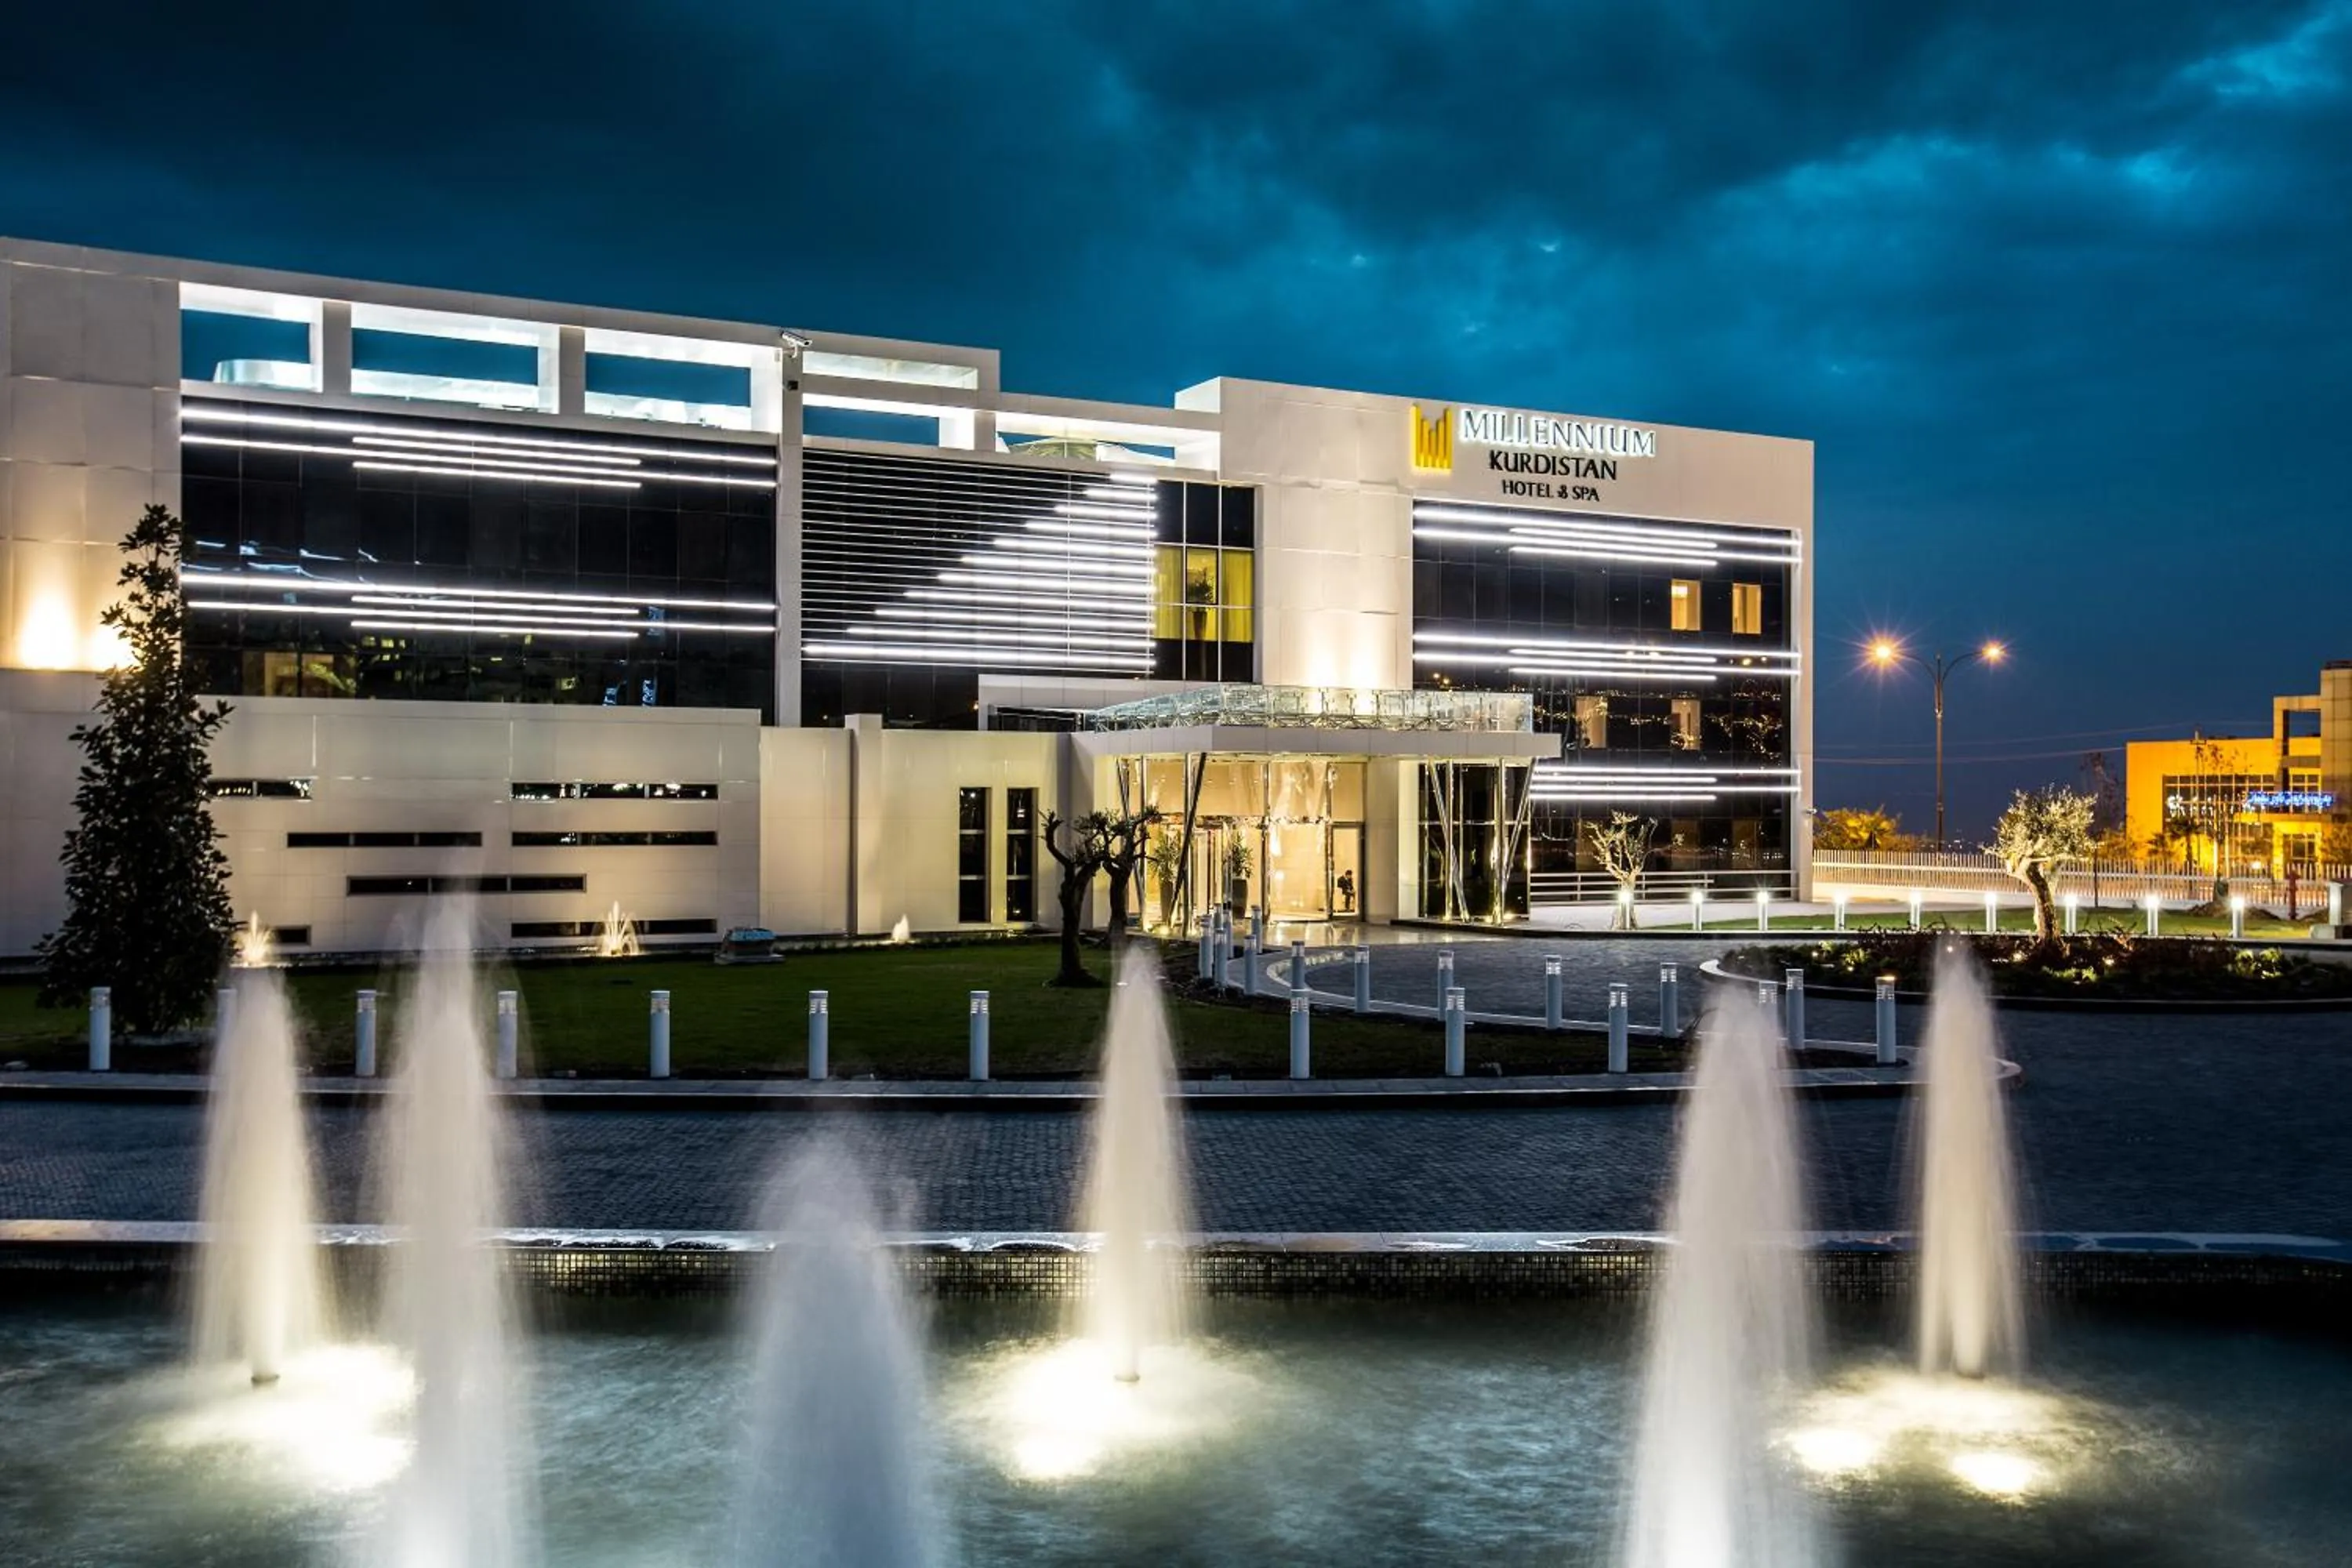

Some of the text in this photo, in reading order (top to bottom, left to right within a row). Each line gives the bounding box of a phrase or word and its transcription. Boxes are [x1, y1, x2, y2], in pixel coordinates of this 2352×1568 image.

[1463, 409, 1655, 455] MILLENNIUM
[1490, 449, 1617, 480] KURDISTAN
[1502, 480, 1599, 501] HOTEL & SPA
